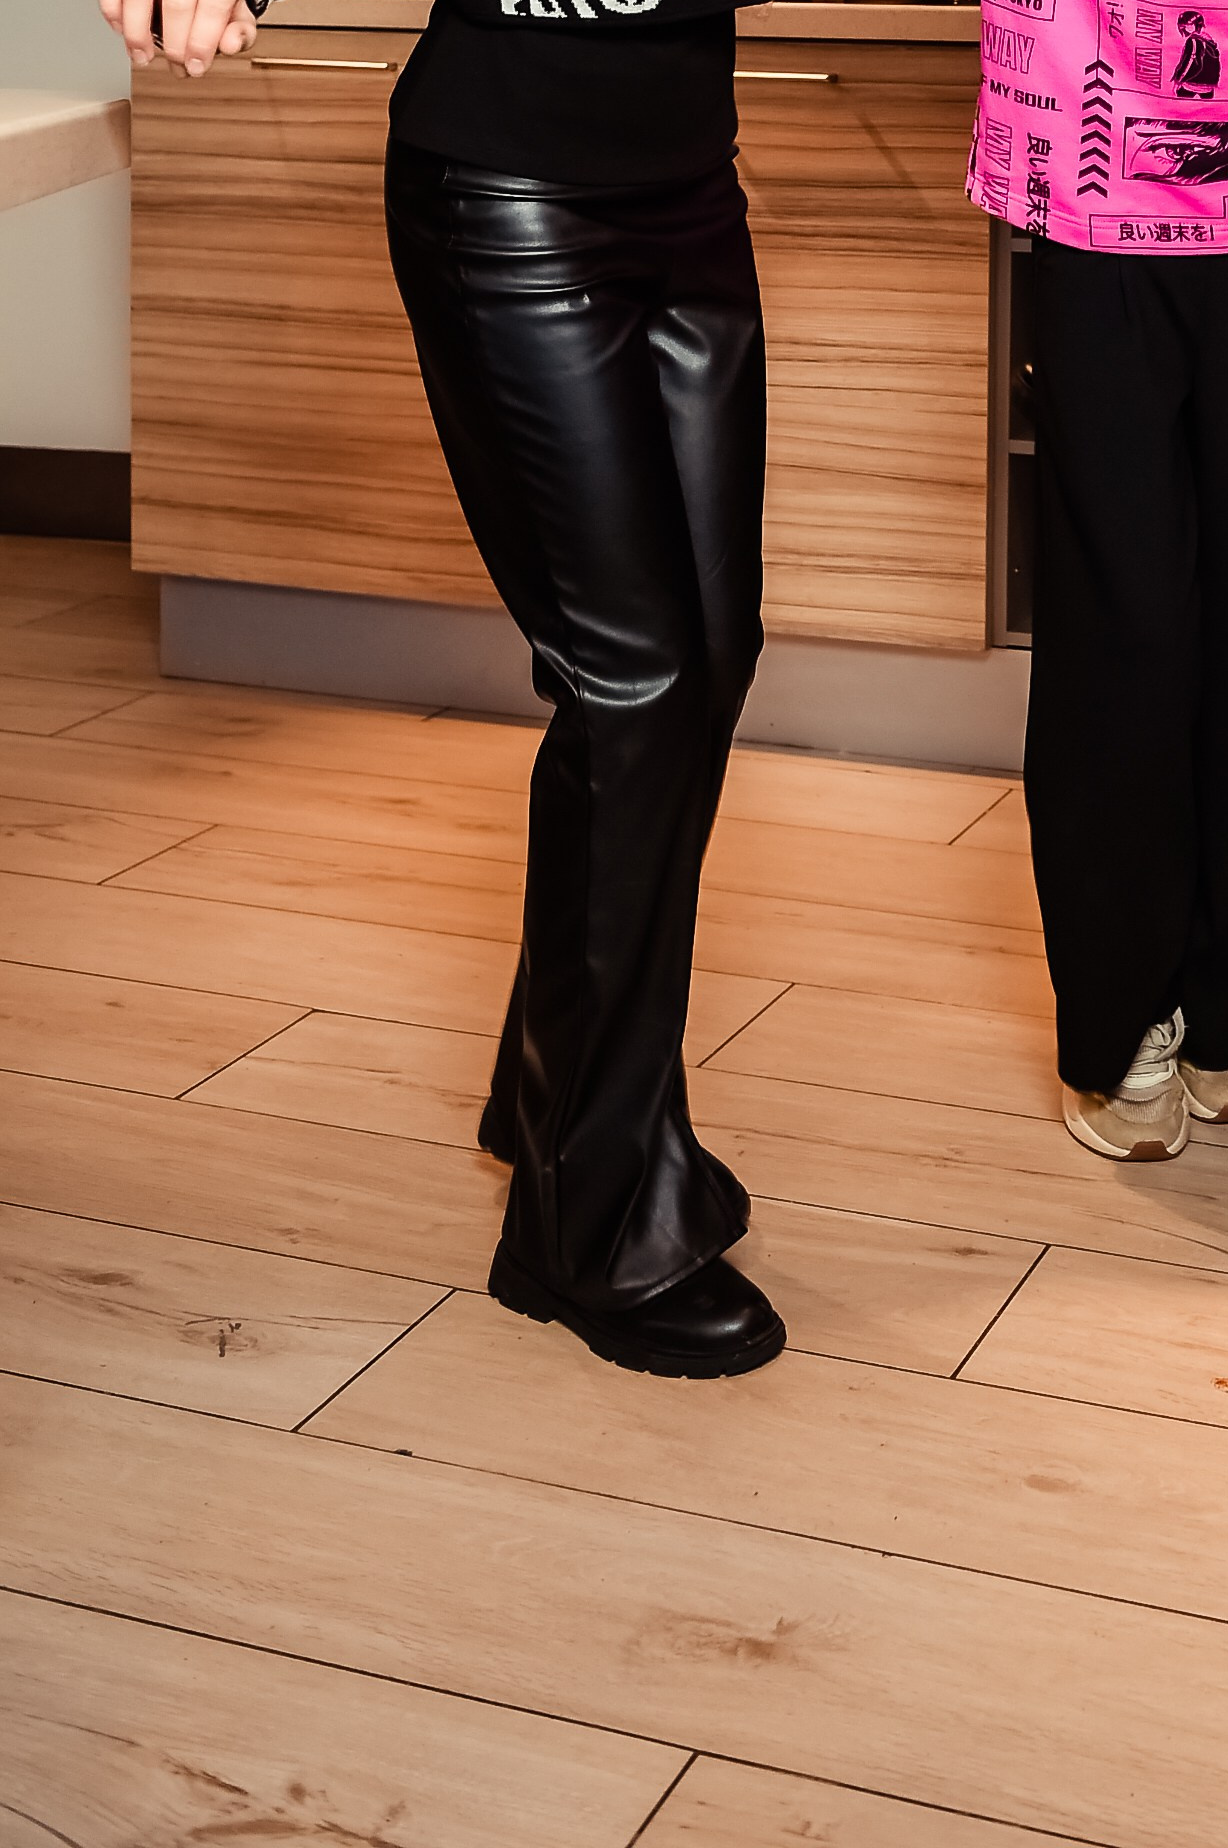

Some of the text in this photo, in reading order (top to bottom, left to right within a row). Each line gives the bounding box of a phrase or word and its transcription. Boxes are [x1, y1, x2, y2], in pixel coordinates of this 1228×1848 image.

[1134, 7, 1164, 90] MY WAY
[989, 83, 1063, 112] MY SOUL
[984, 116, 1013, 171] MY
